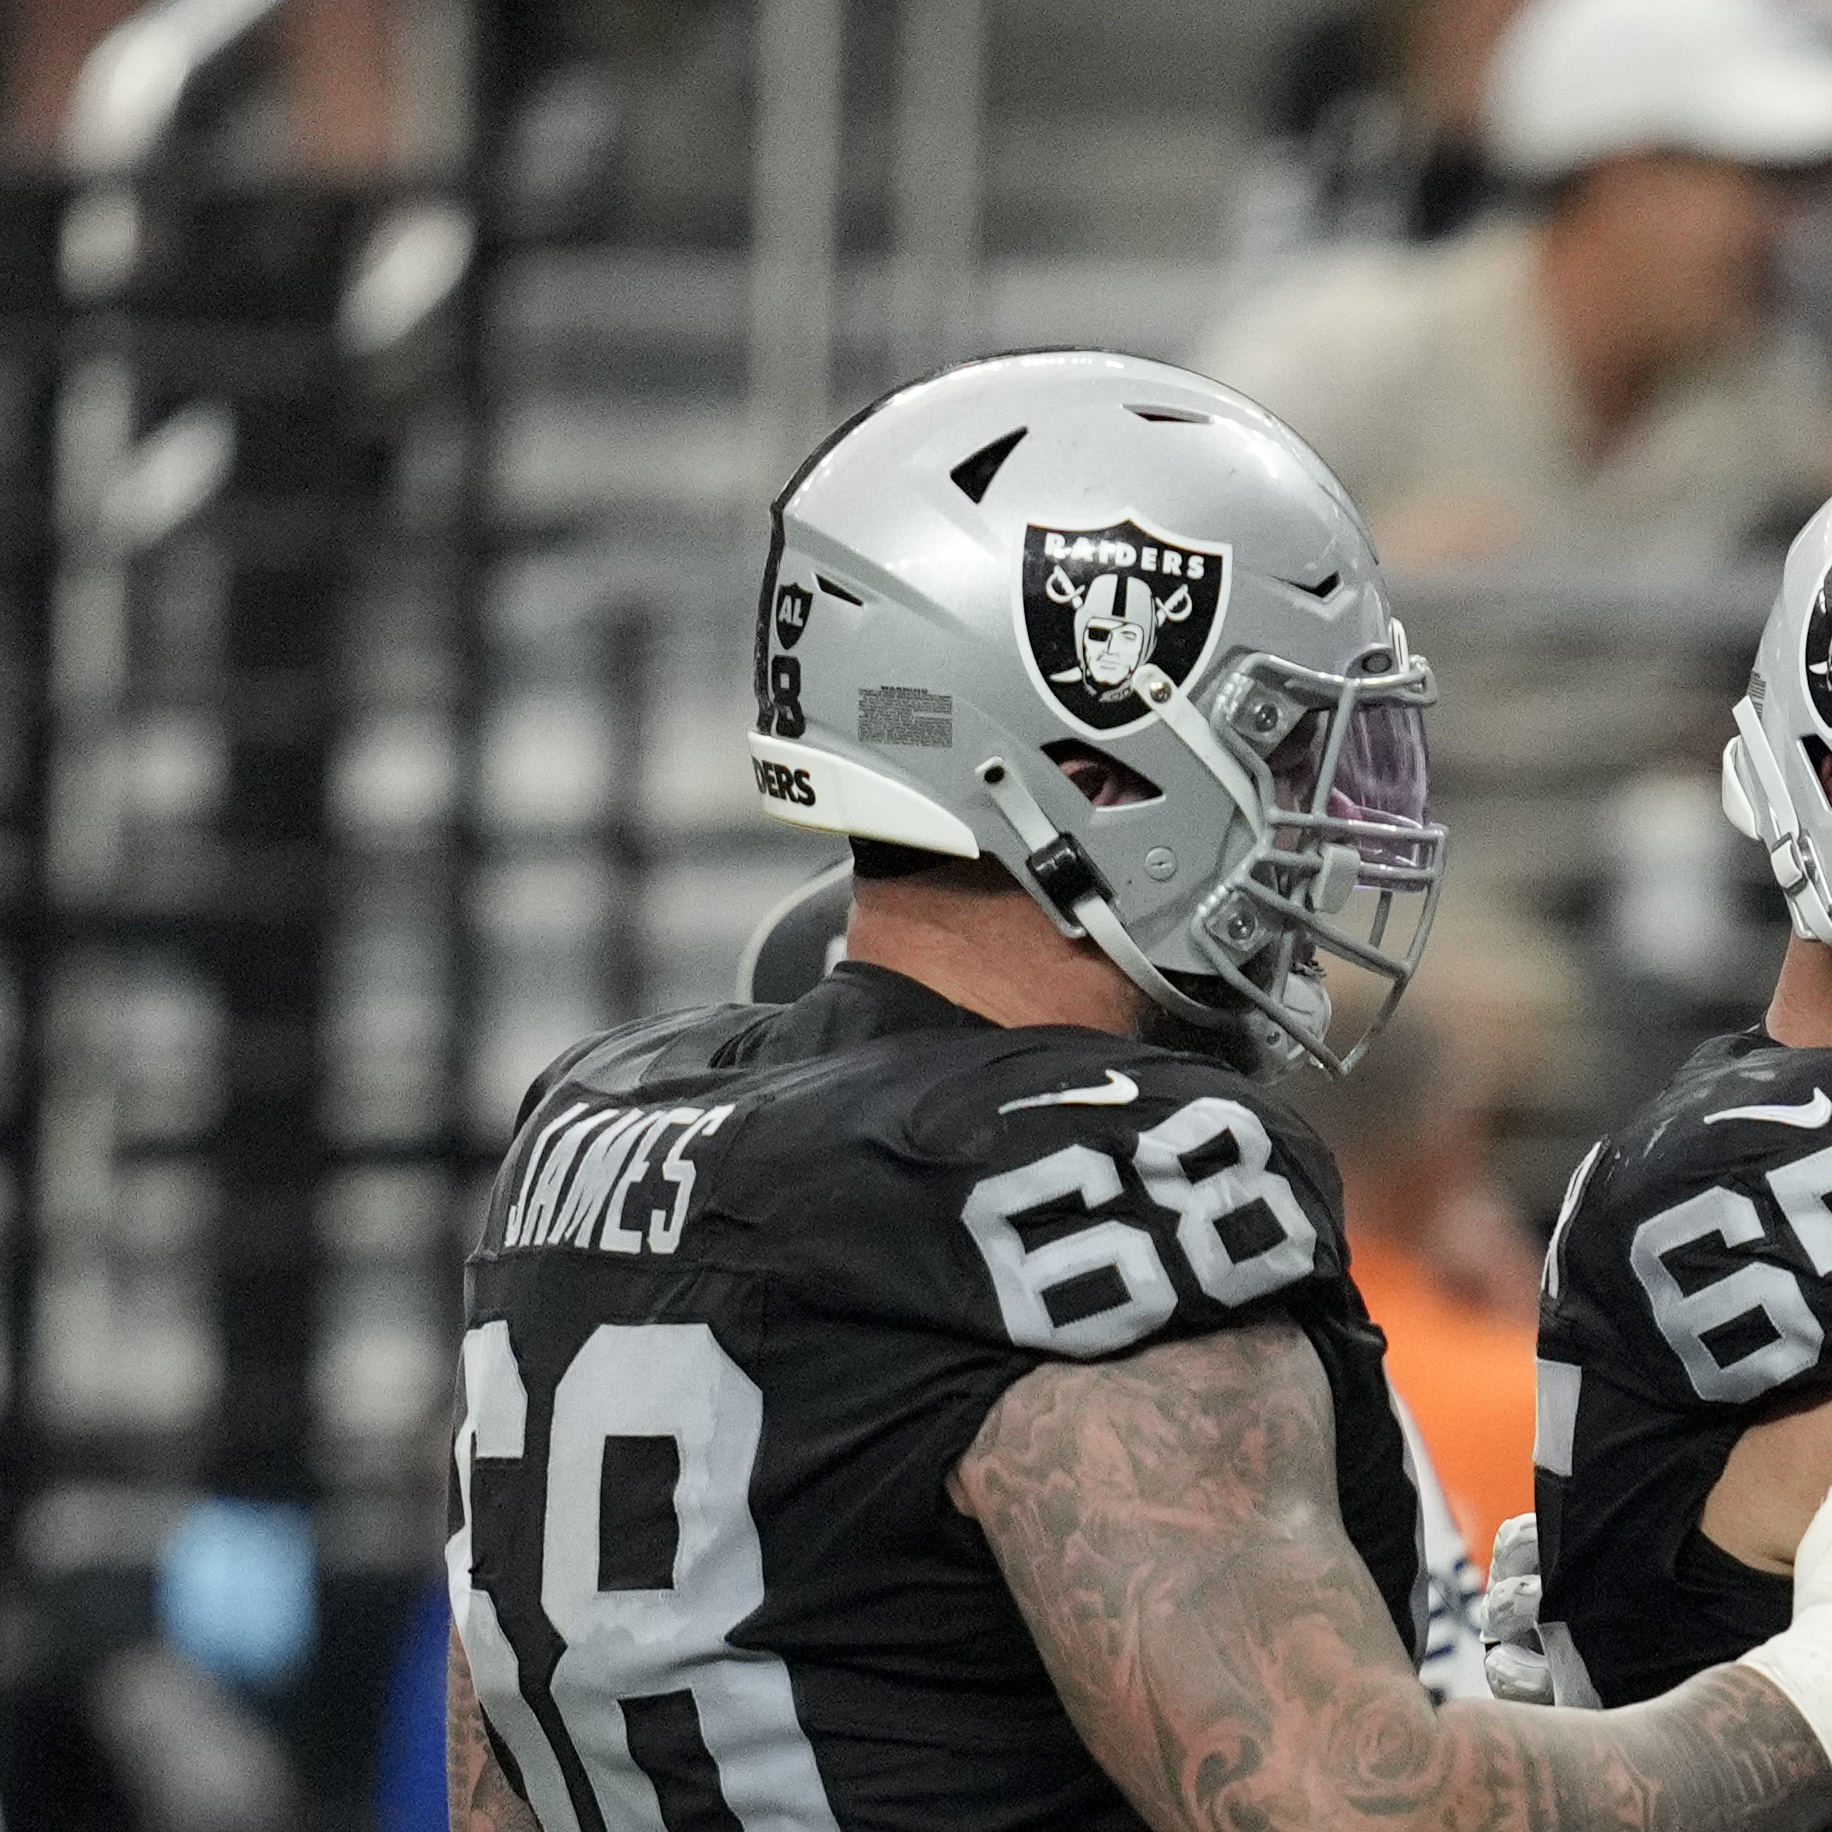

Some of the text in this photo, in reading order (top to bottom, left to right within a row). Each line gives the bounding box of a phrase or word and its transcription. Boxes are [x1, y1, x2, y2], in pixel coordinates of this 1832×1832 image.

[1045, 532, 1206, 580] RAIDERS
[778, 595, 804, 628] AL
[751, 754, 816, 807] DERS
[503, 1102, 737, 1254] JAMES
[961, 1097, 1316, 1359] 68
